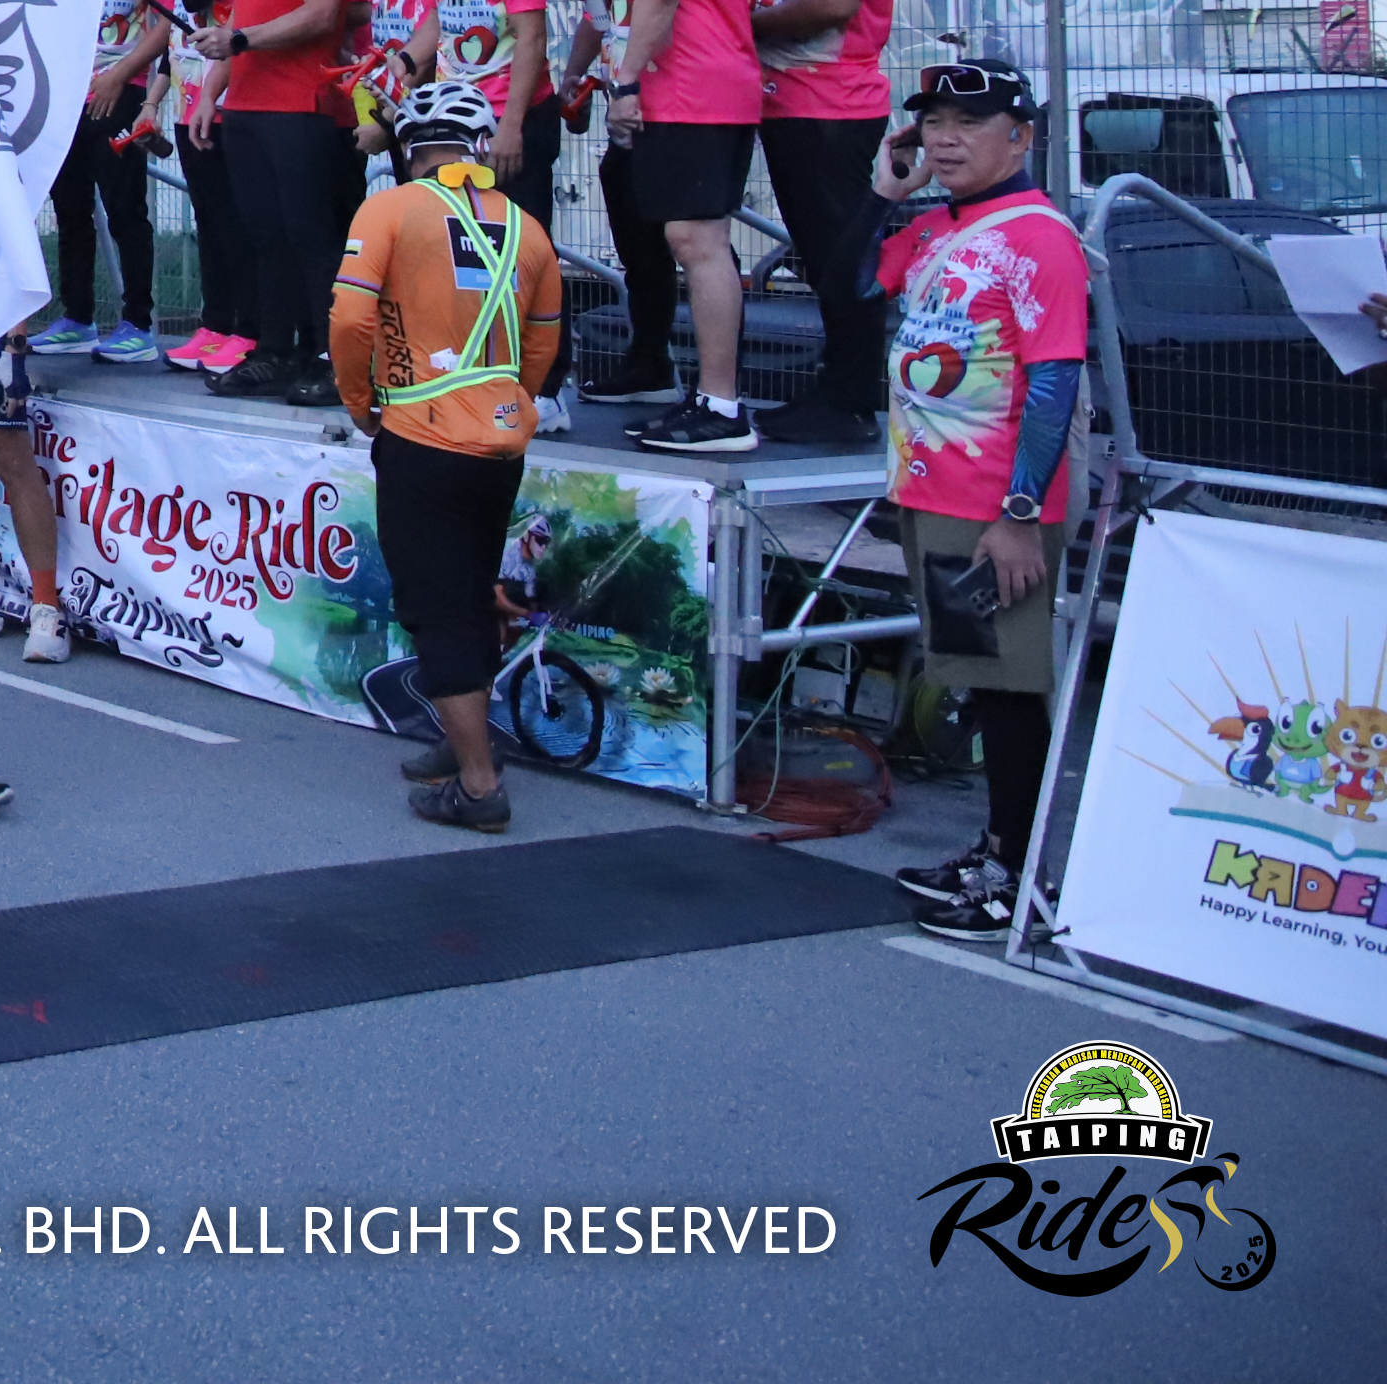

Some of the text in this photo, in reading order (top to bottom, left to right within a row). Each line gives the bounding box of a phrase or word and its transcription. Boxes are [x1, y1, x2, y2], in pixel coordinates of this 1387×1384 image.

[210, 481, 359, 602] Ride
[66, 566, 224, 668] Taiping
[183, 564, 259, 611] 2025
[577, 624, 617, 640] AIPING
[1200, 894, 1387, 956] Happy Learning, You
